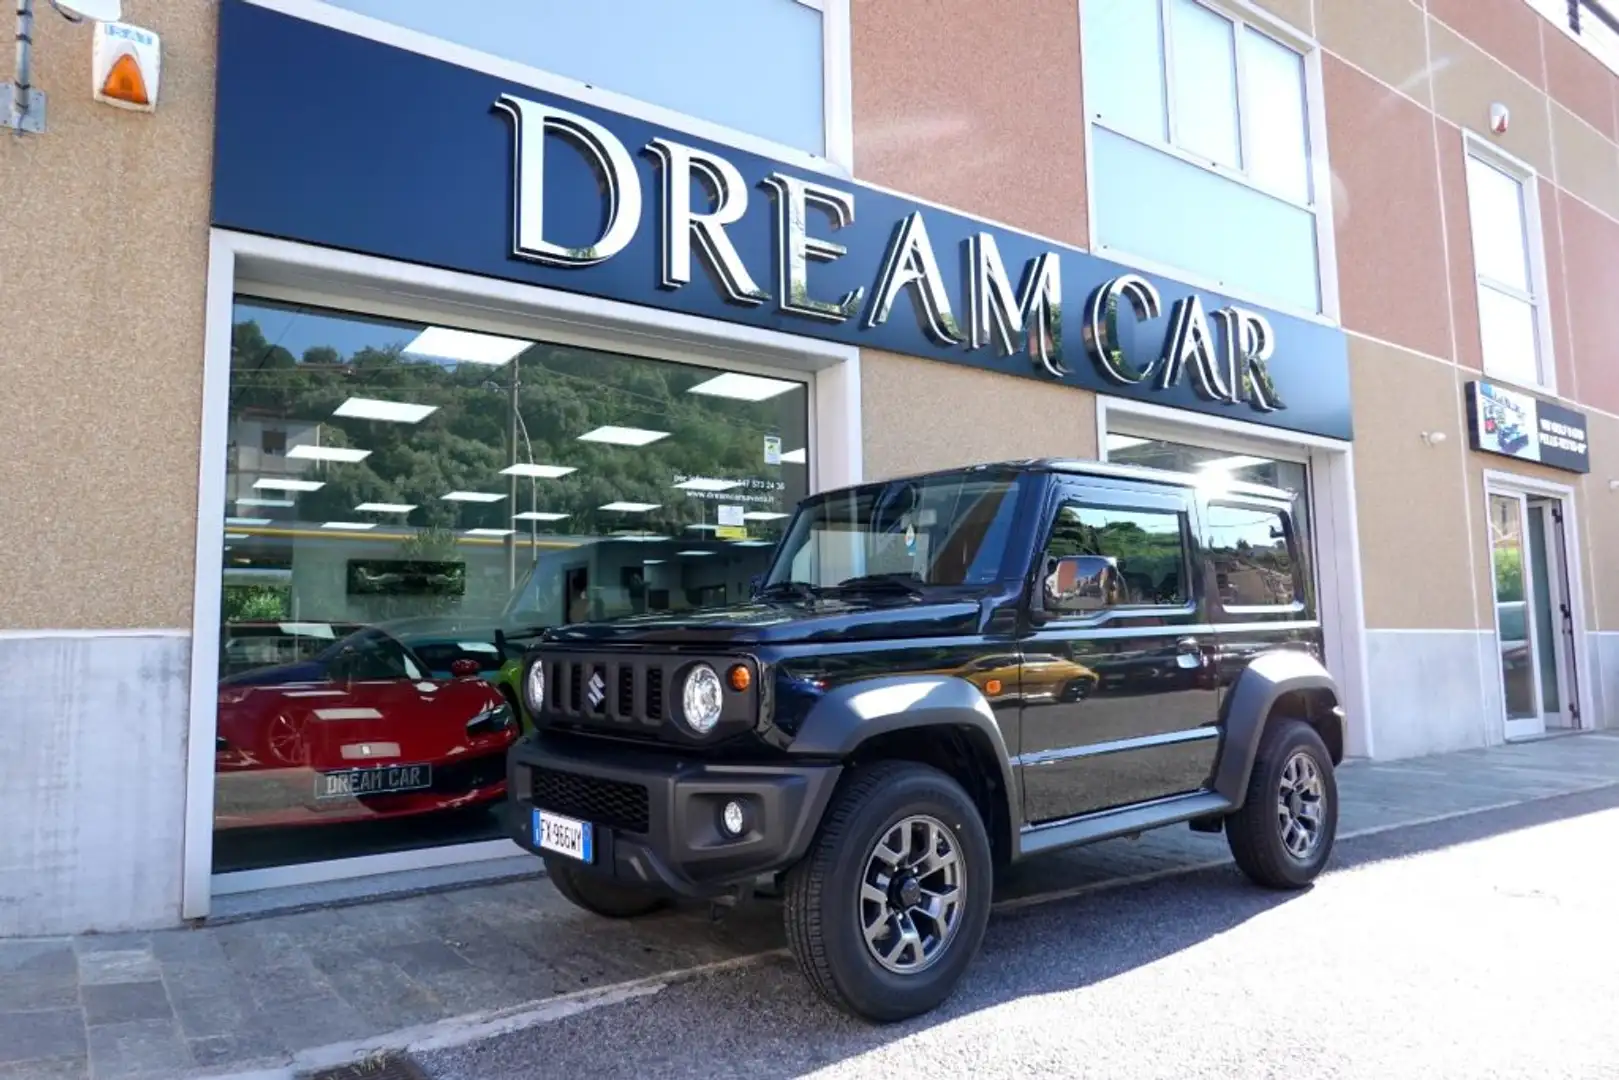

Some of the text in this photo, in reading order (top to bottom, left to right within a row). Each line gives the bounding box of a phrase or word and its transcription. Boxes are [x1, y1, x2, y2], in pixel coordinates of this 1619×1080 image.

[494, 92, 1284, 411] DREAM CAR
[326, 766, 421, 794] DREAM CAR
